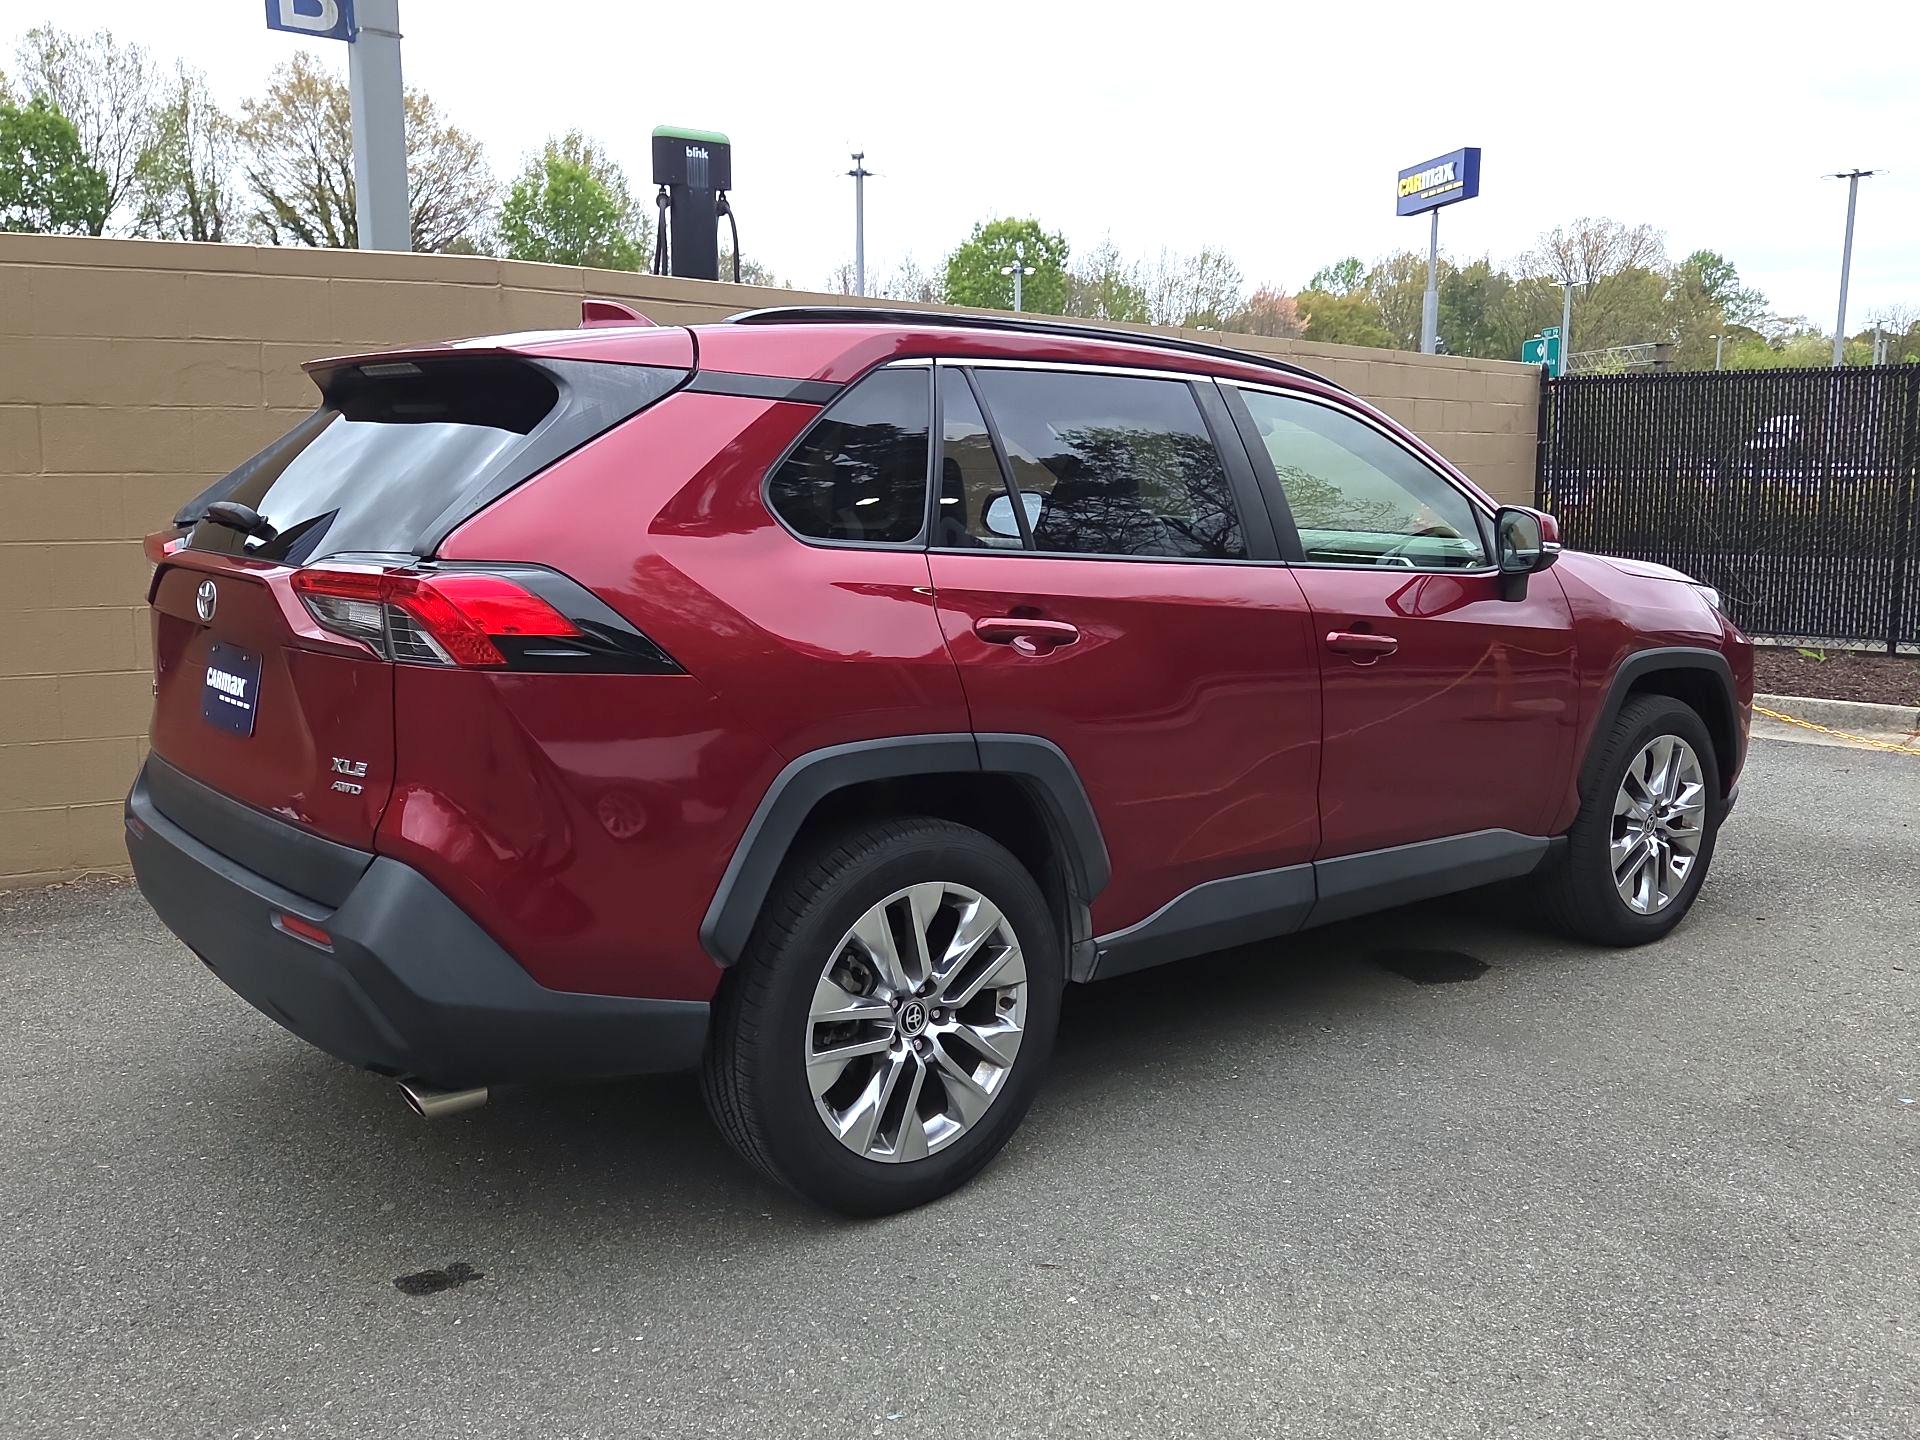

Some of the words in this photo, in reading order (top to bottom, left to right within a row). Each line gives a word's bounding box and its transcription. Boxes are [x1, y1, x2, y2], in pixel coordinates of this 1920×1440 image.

[685, 145, 709, 159] blink
[331, 757, 368, 778] XLE
[330, 781, 362, 795] AWD
